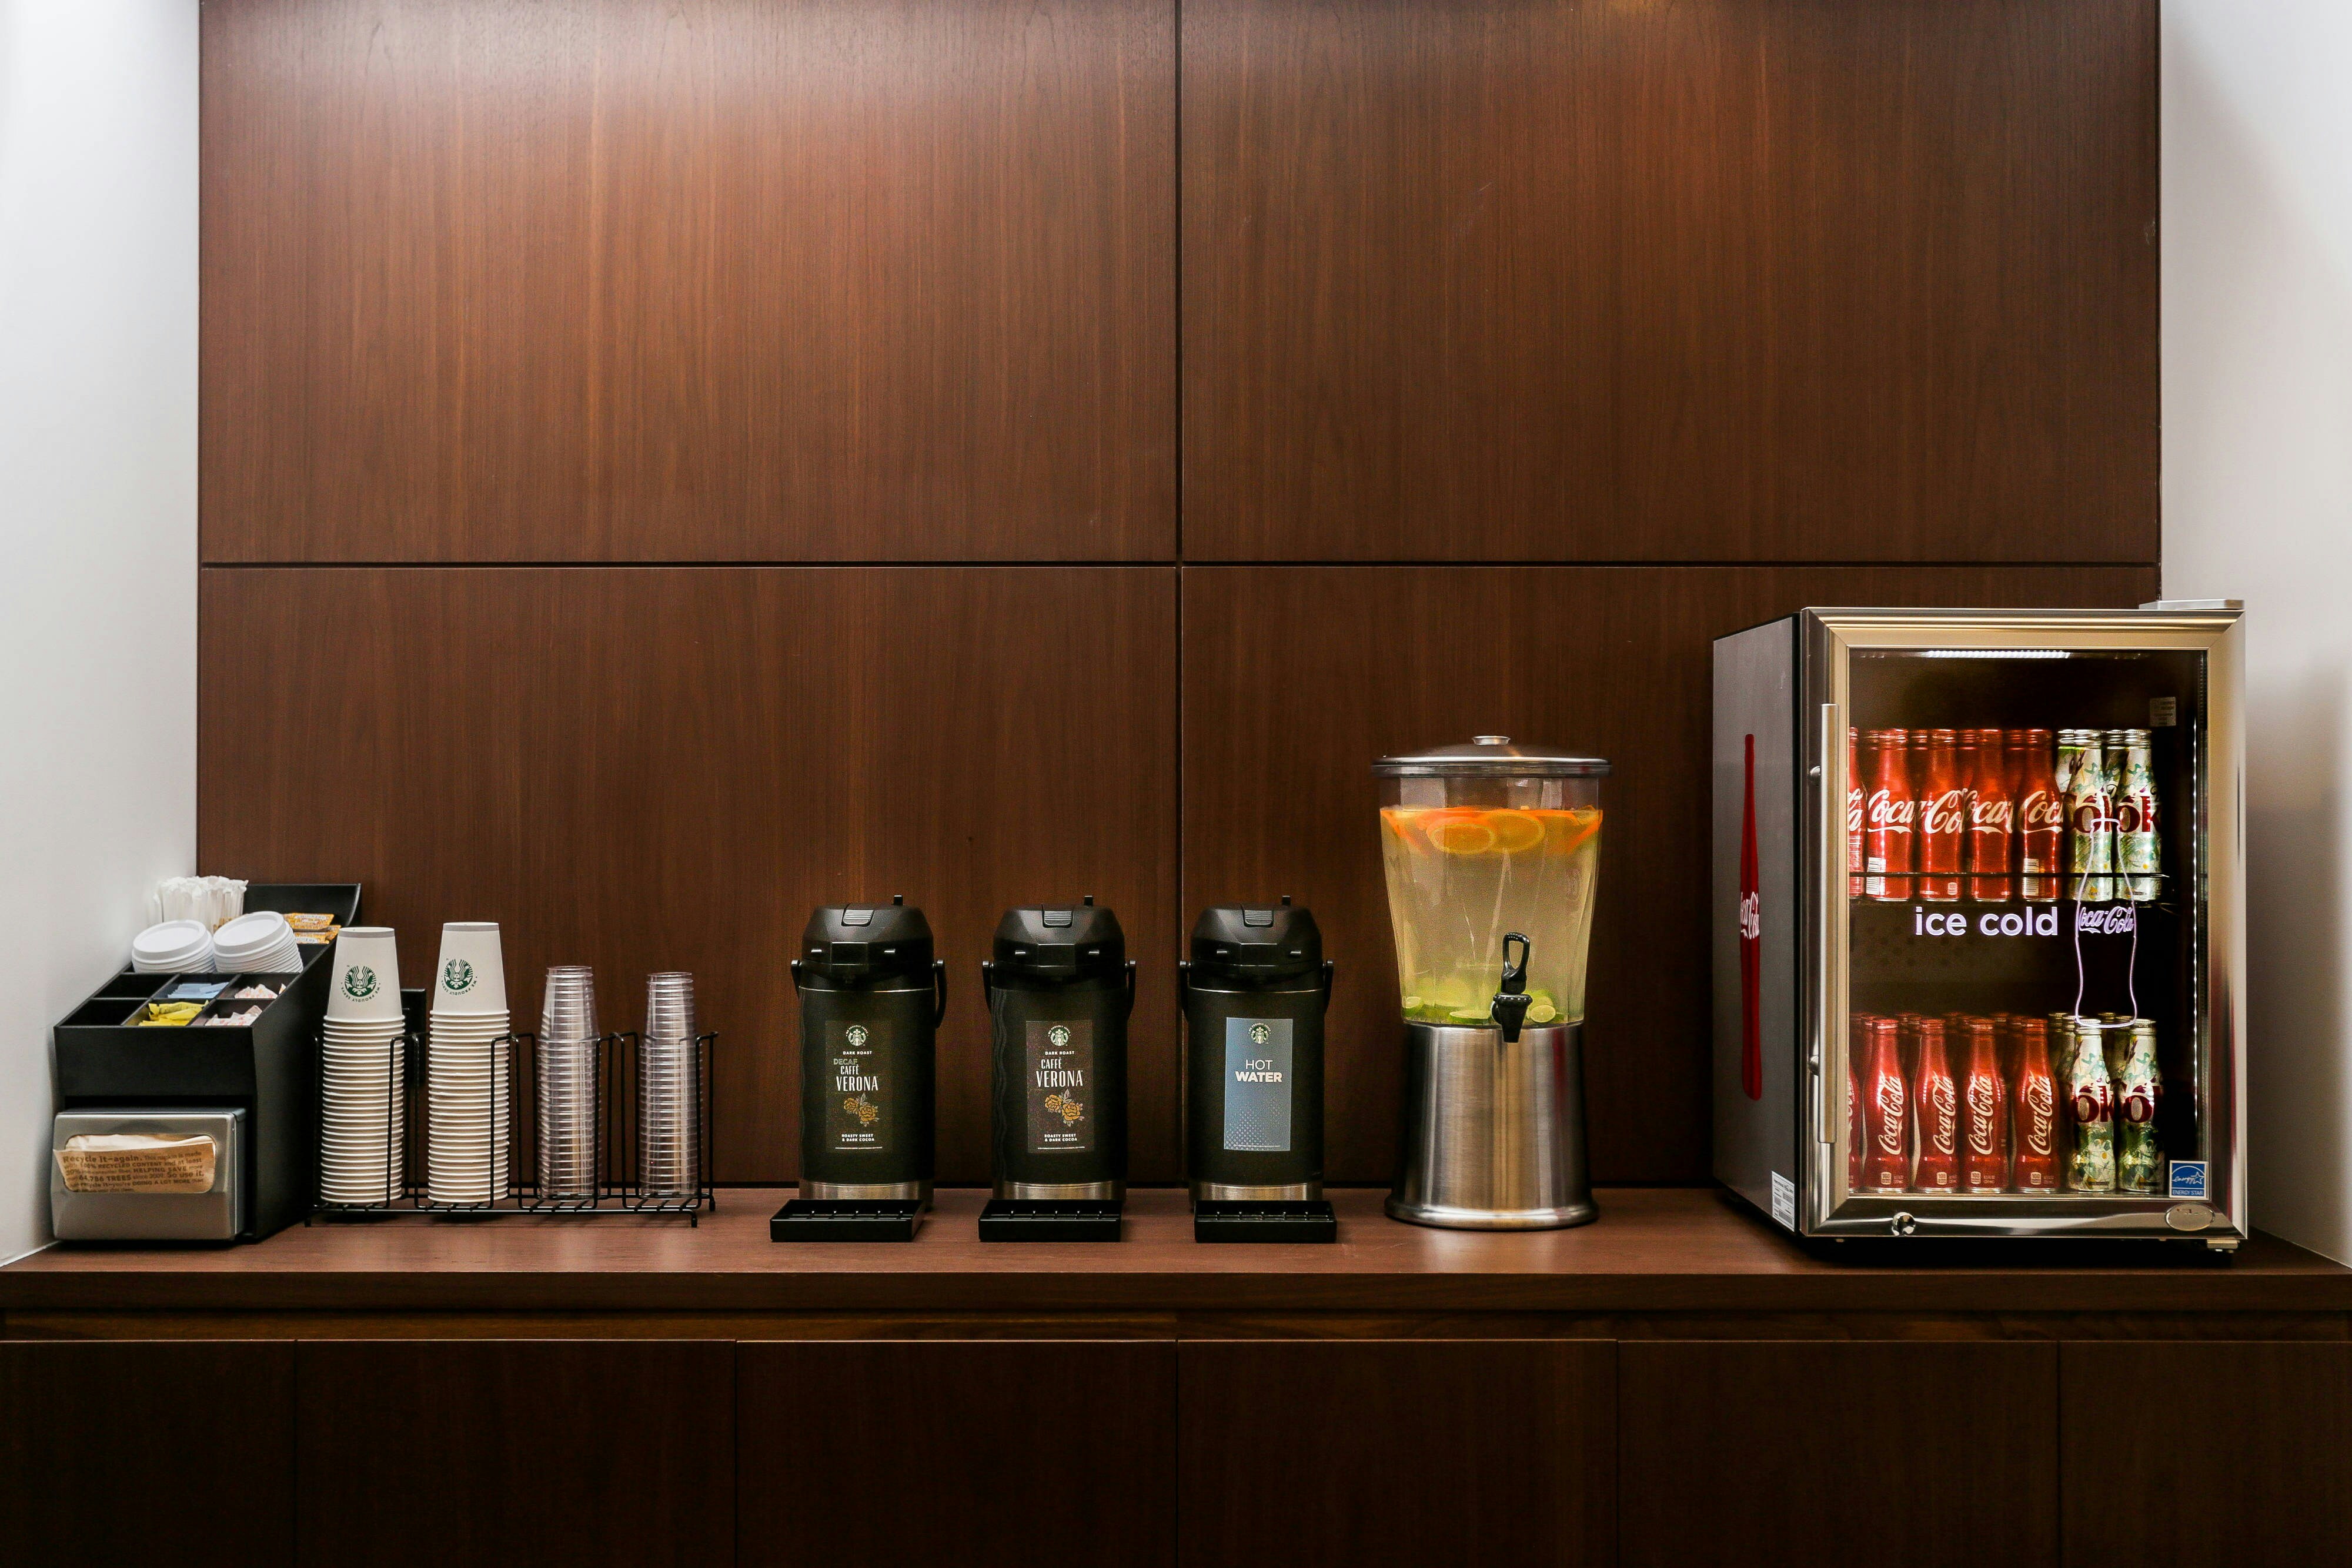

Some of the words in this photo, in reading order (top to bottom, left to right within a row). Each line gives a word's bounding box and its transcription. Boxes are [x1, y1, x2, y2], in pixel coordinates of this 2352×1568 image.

[1915, 906, 1967, 936] ice
[1979, 906, 2059, 936] cold
[840, 1064, 859, 1075] CAFFÈ
[1041, 1057, 1063, 1069] CAFFÈ
[1245, 1059, 1273, 1071] HOT
[836, 1076, 878, 1091] VERONA
[1036, 1070, 1083, 1088] VERONA
[1235, 1071, 1282, 1082] WATER
[1878, 1070, 1904, 1155] Coca-Cola
[1932, 1071, 1956, 1155] Coca-Cola
[1967, 1071, 1993, 1155] Coca-Cola
[2027, 1070, 2053, 1155] Coca-Cola
[62, 1155, 96, 1164] Recycle
